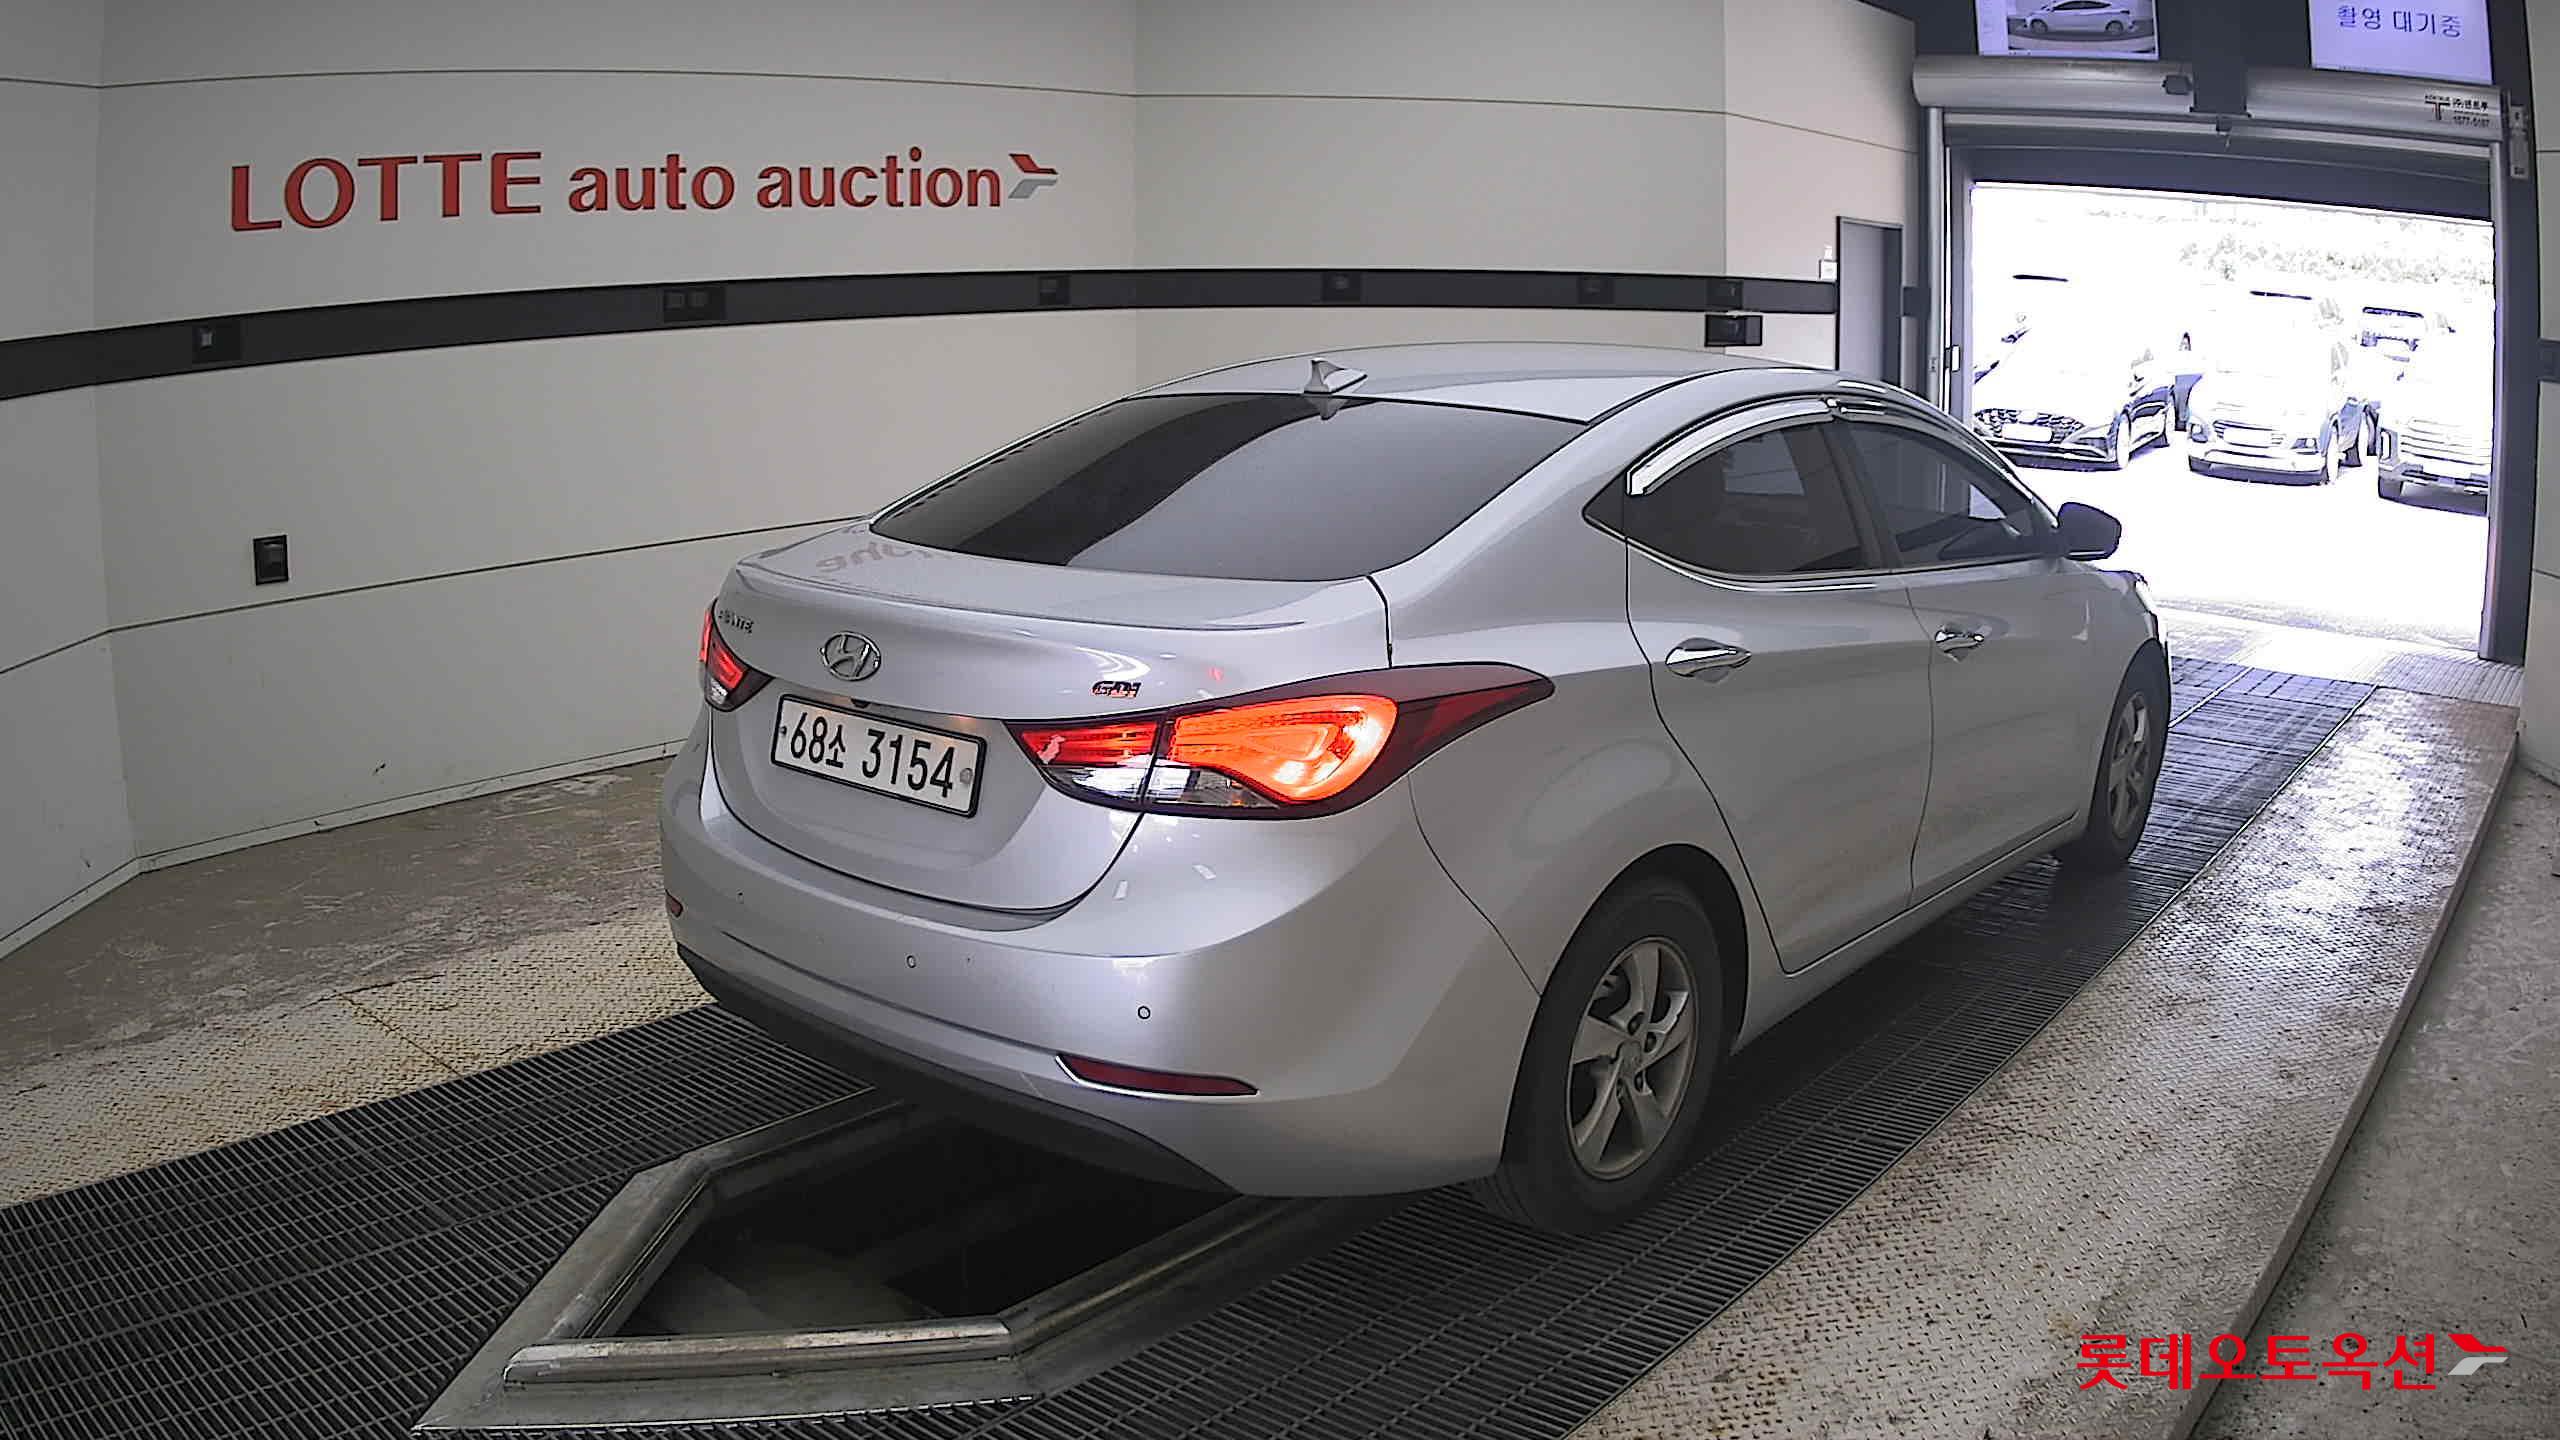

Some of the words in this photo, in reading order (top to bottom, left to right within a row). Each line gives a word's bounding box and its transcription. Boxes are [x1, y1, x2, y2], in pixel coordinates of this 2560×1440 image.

[2338, 4, 2381, 31] 촬영
[2392, 10, 2461, 38] 대기중
[230, 151, 542, 232] LOTTE
[568, 153, 735, 212] auto
[757, 147, 1001, 209] auction
[790, 711, 847, 769] 68소
[861, 727, 956, 799] 3154
